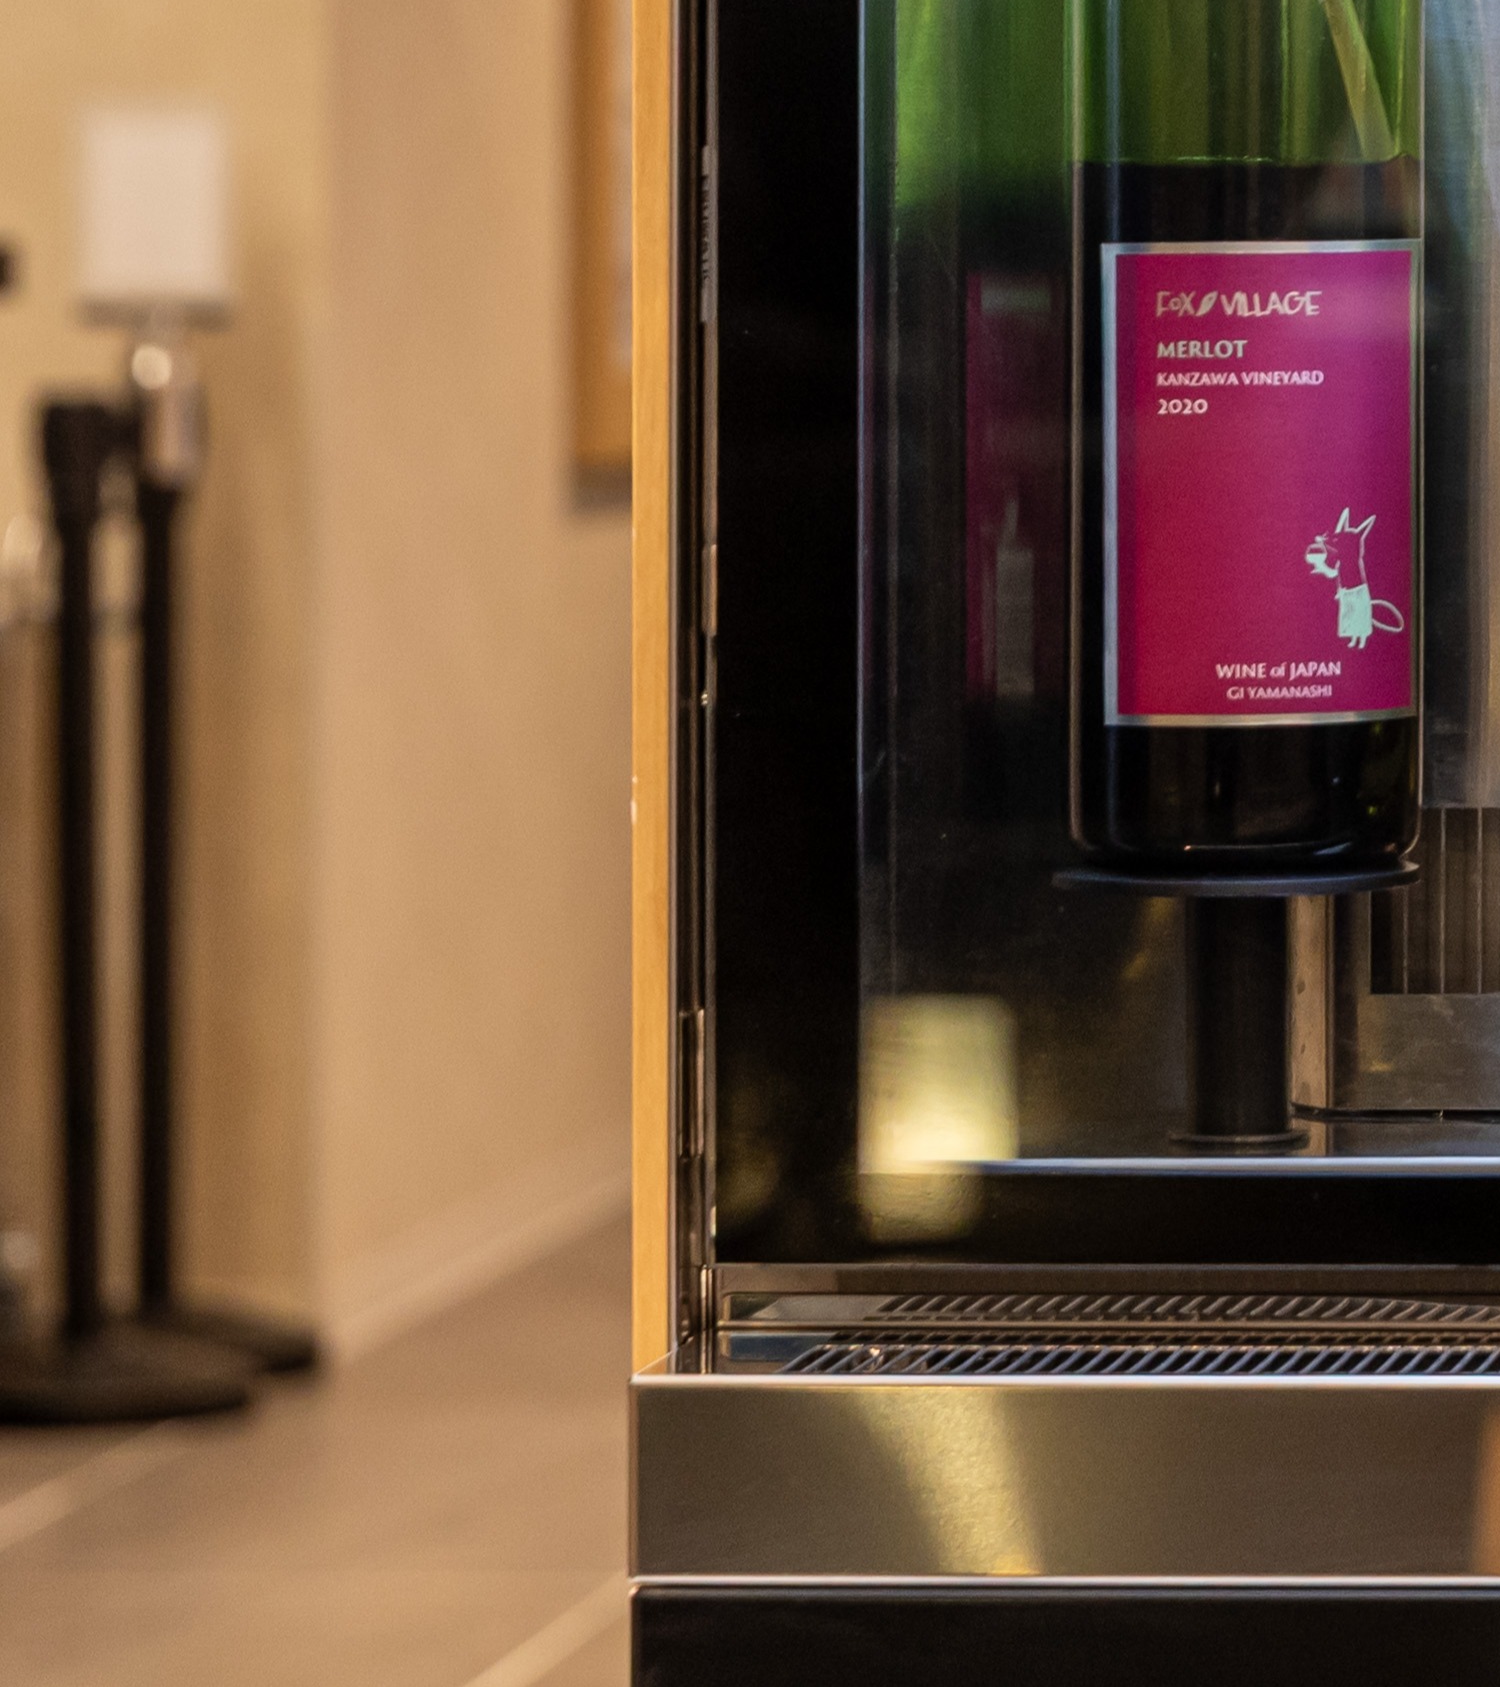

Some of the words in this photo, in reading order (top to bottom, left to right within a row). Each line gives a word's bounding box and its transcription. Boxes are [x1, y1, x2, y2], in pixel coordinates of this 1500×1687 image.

[1220, 291, 1323, 317] VILLAGE
[1157, 340, 1248, 359] MERLOT
[1156, 372, 1239, 387] KANZAWA
[1241, 370, 1325, 386] VINEYARD
[1158, 398, 1208, 415] 2020
[1216, 662, 1267, 680] WINE
[1269, 662, 1287, 679] of
[1289, 661, 1342, 681] JAPAN
[1227, 686, 1244, 700] GI
[1247, 684, 1333, 700] YAMANASHI
